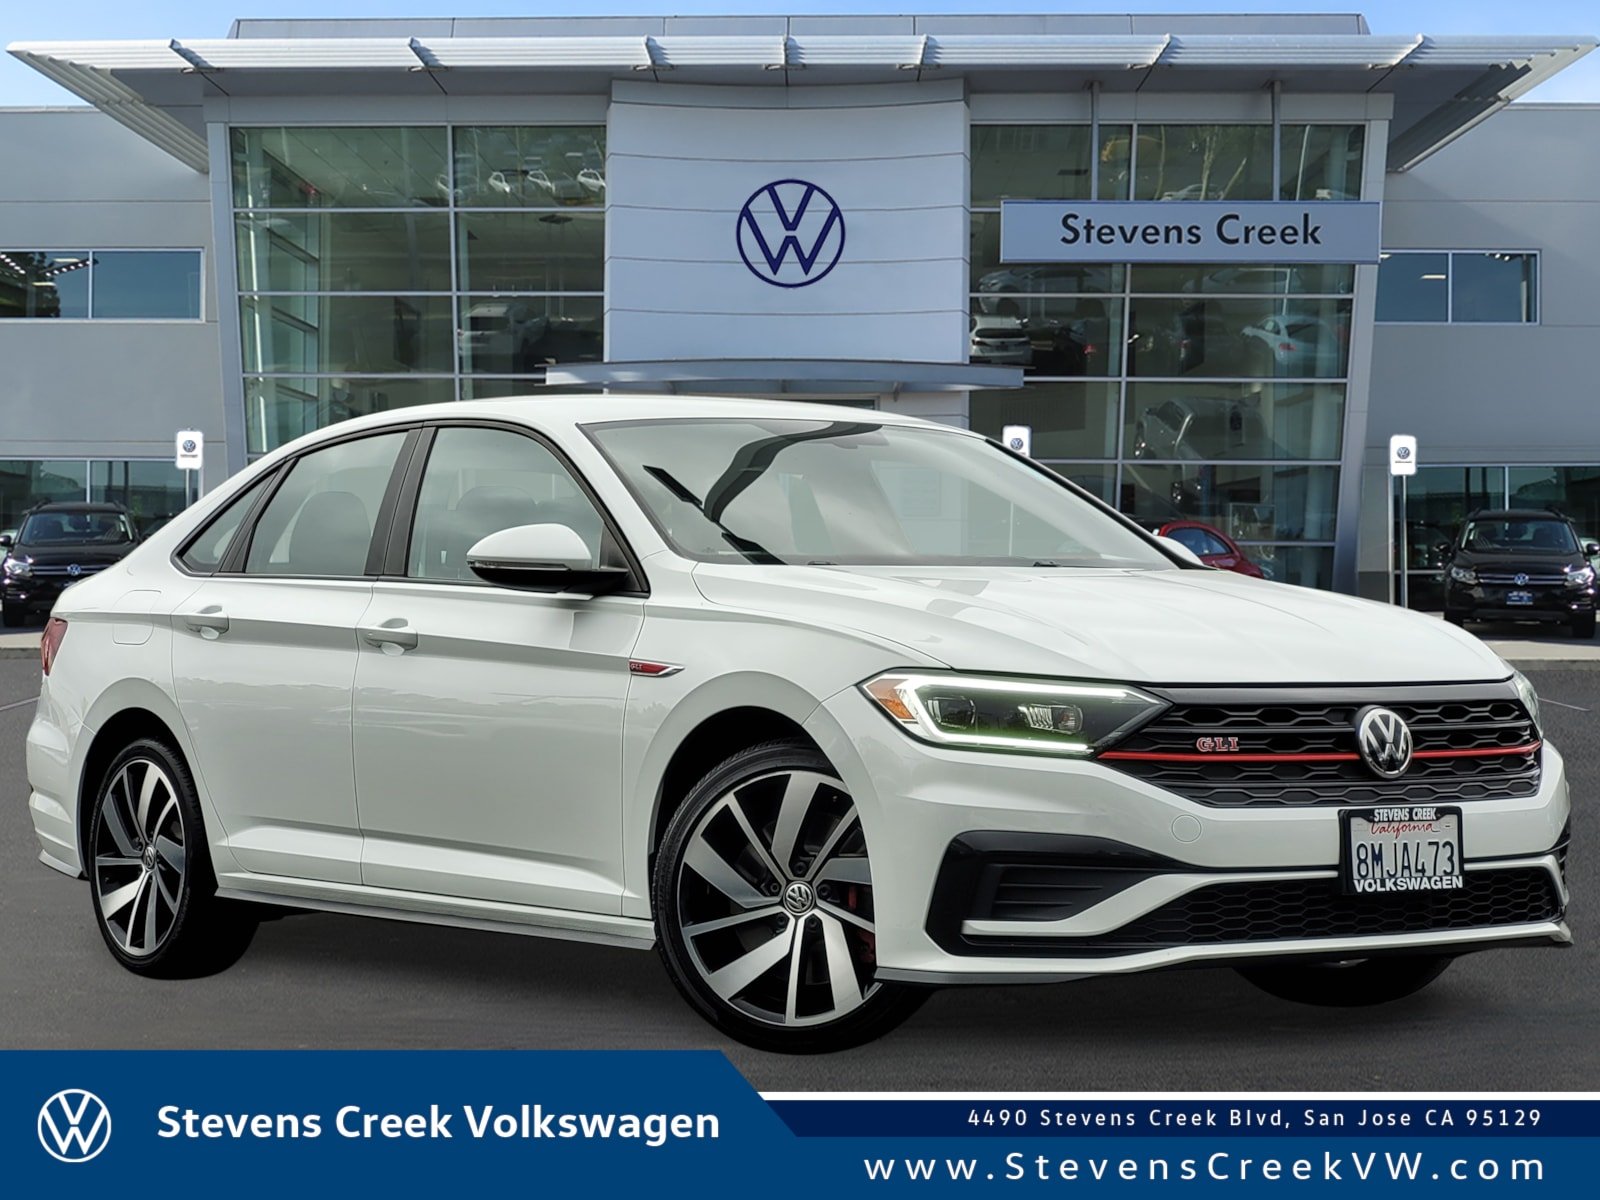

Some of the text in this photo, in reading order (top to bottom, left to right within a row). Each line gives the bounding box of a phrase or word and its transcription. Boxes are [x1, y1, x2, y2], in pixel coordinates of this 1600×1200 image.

[1060, 213, 1322, 246] Stevens Creek
[1196, 736, 1240, 752] GLI
[1373, 807, 1437, 822] STEVENS CREEK
[1371, 822, 1440, 840] California
[1356, 840, 1455, 878] 8MJA473
[1353, 875, 1463, 893] VOLKSWAGEN
